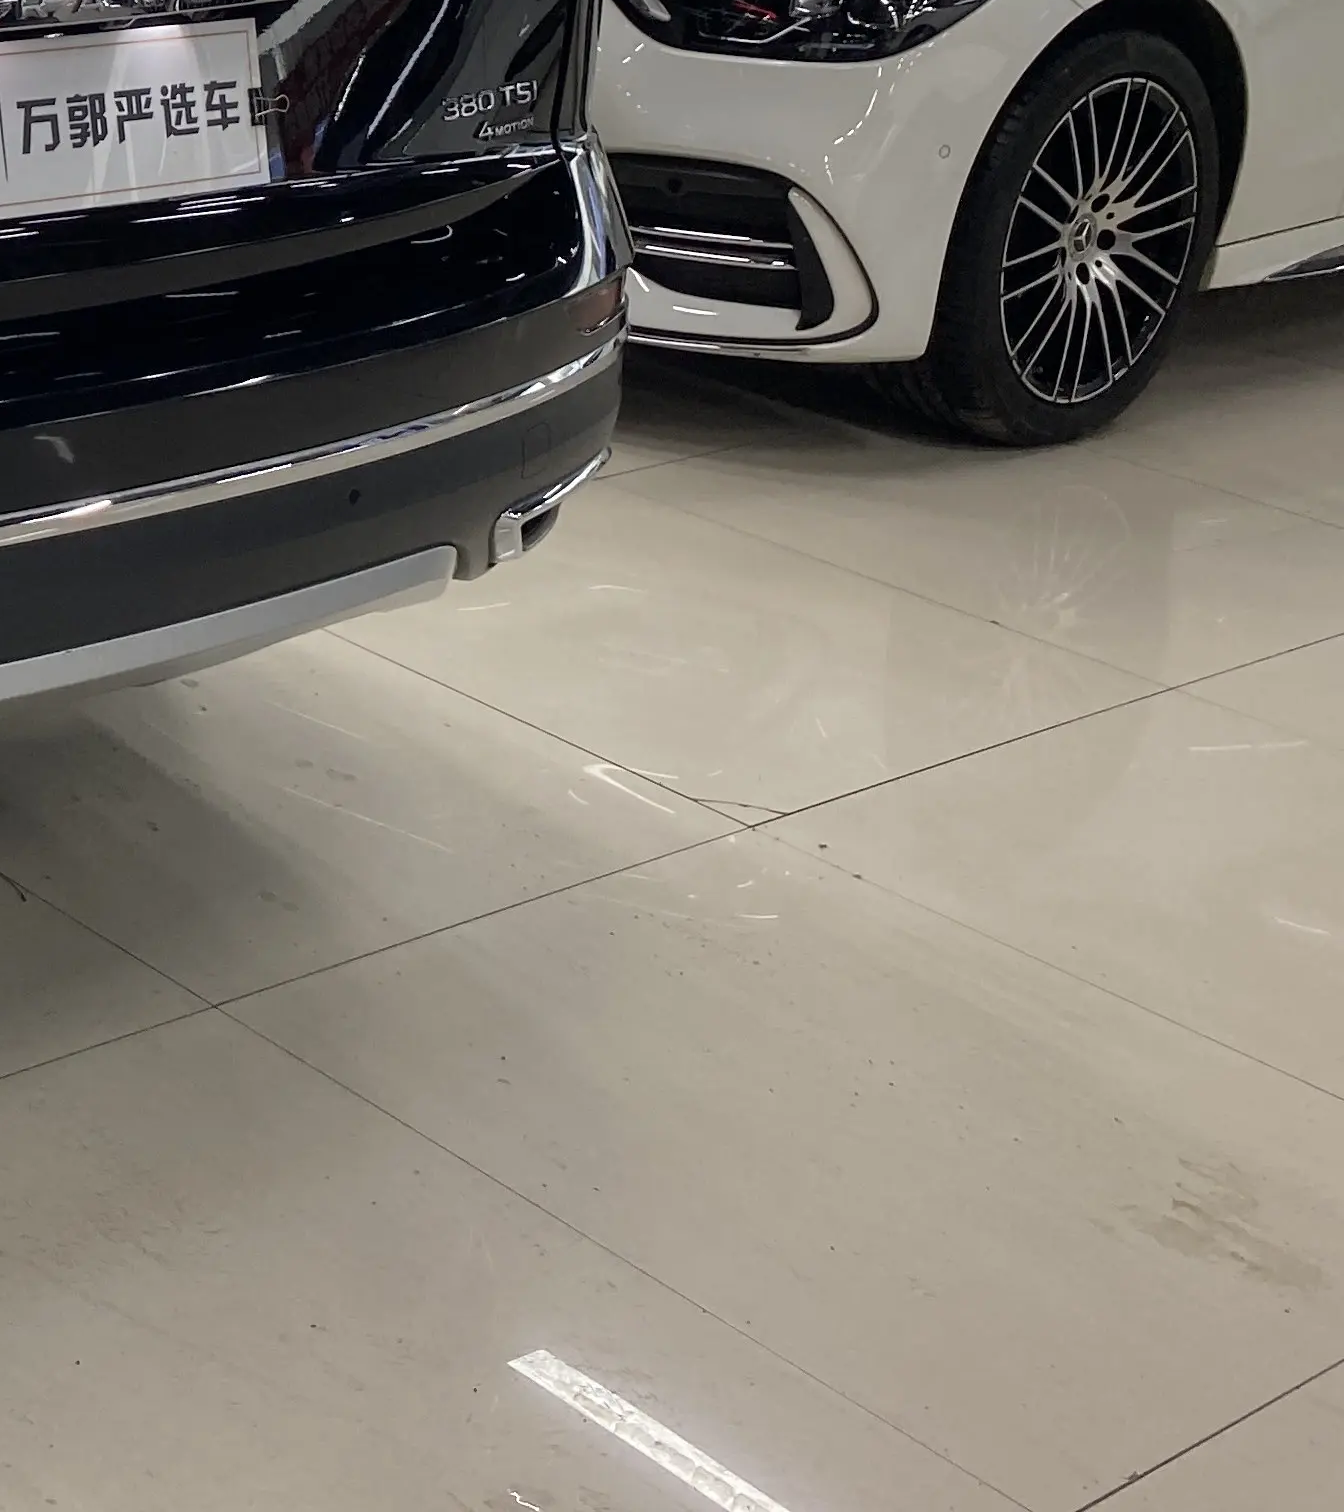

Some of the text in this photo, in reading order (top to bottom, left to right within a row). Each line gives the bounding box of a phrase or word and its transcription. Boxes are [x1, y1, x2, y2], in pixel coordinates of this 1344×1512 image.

[15, 80, 240, 155] 万郭严选车
[441, 80, 538, 122] 380 TSI
